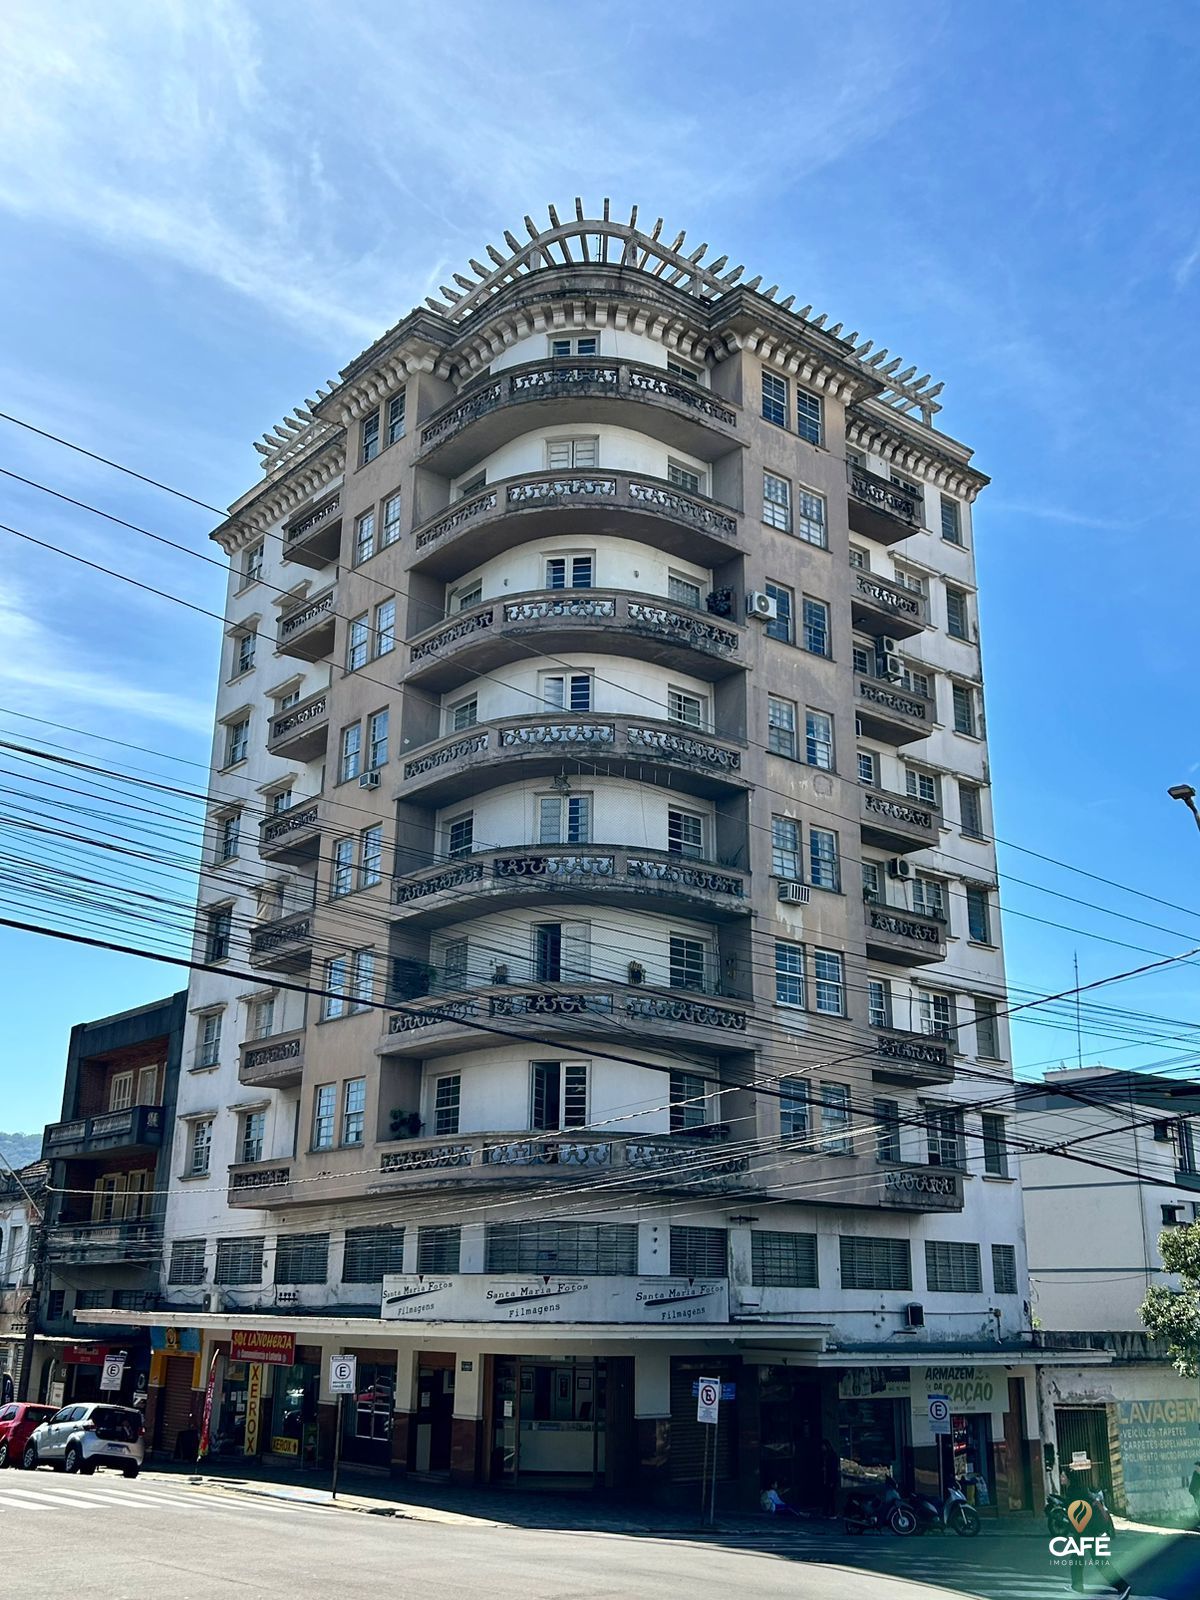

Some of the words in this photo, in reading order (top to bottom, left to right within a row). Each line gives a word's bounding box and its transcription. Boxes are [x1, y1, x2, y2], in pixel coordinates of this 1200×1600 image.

[383, 1290, 401, 1299] Santa
[404, 1285, 425, 1295] Maria
[428, 1281, 453, 1291] Fotos
[486, 1290, 516, 1300] Santa
[520, 1286, 551, 1297] Maria
[557, 1283, 589, 1293] Fotos
[636, 1291, 665, 1301] Santa
[668, 1288, 696, 1298] Maria
[700, 1285, 724, 1295] Fotos
[397, 1303, 435, 1316] Filmagens
[508, 1303, 561, 1318] Filmagens
[661, 1306, 706, 1320] Filmagens
[233, 1331, 247, 1346] SOL
[109, 1366, 117, 1375] E
[339, 1366, 347, 1377] E
[933, 1383, 943, 1391] DA
[246, 1365, 260, 1453] XEROX
[935, 1404, 943, 1417] E
[1116, 1400, 1198, 1424] LAVAGEM
